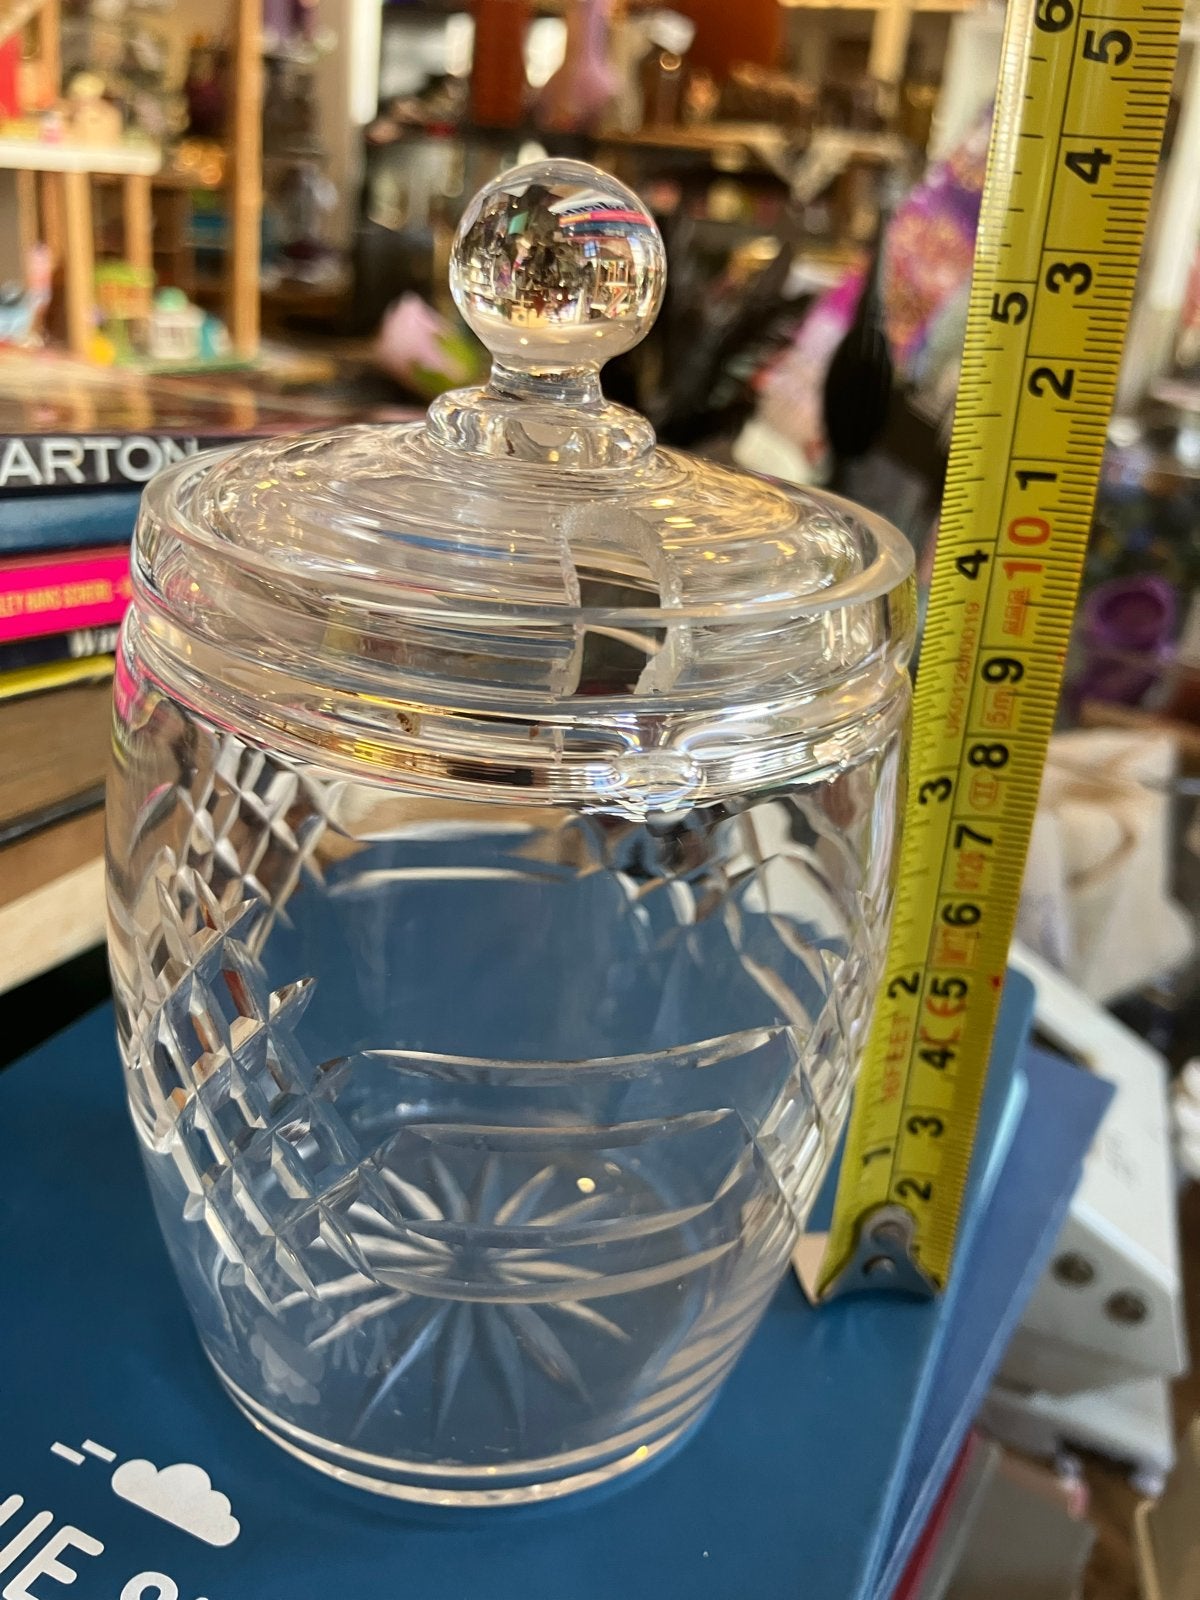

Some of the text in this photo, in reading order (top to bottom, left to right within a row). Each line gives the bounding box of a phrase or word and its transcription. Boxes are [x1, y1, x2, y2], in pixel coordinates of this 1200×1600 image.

[1083, 28, 1134, 66] 5
[1065, 147, 1113, 184] 4
[1045, 261, 1093, 296] 3
[990, 291, 1029, 326] 5
[1028, 366, 1076, 401] 2
[956, 549, 989, 581] 4
[981, 656, 1026, 685] 9
[967, 743, 1010, 770] 8
[917, 775, 952, 806] 3
[954, 823, 994, 850] 7
[941, 902, 982, 928] 6
[887, 971, 921, 1000] 2
[931, 975, 968, 1000] 5
[919, 1047, 956, 1071] 4
[905, 1114, 945, 1139] 3
[862, 1145, 891, 1167] 1
[894, 1176, 932, 1201] 2
